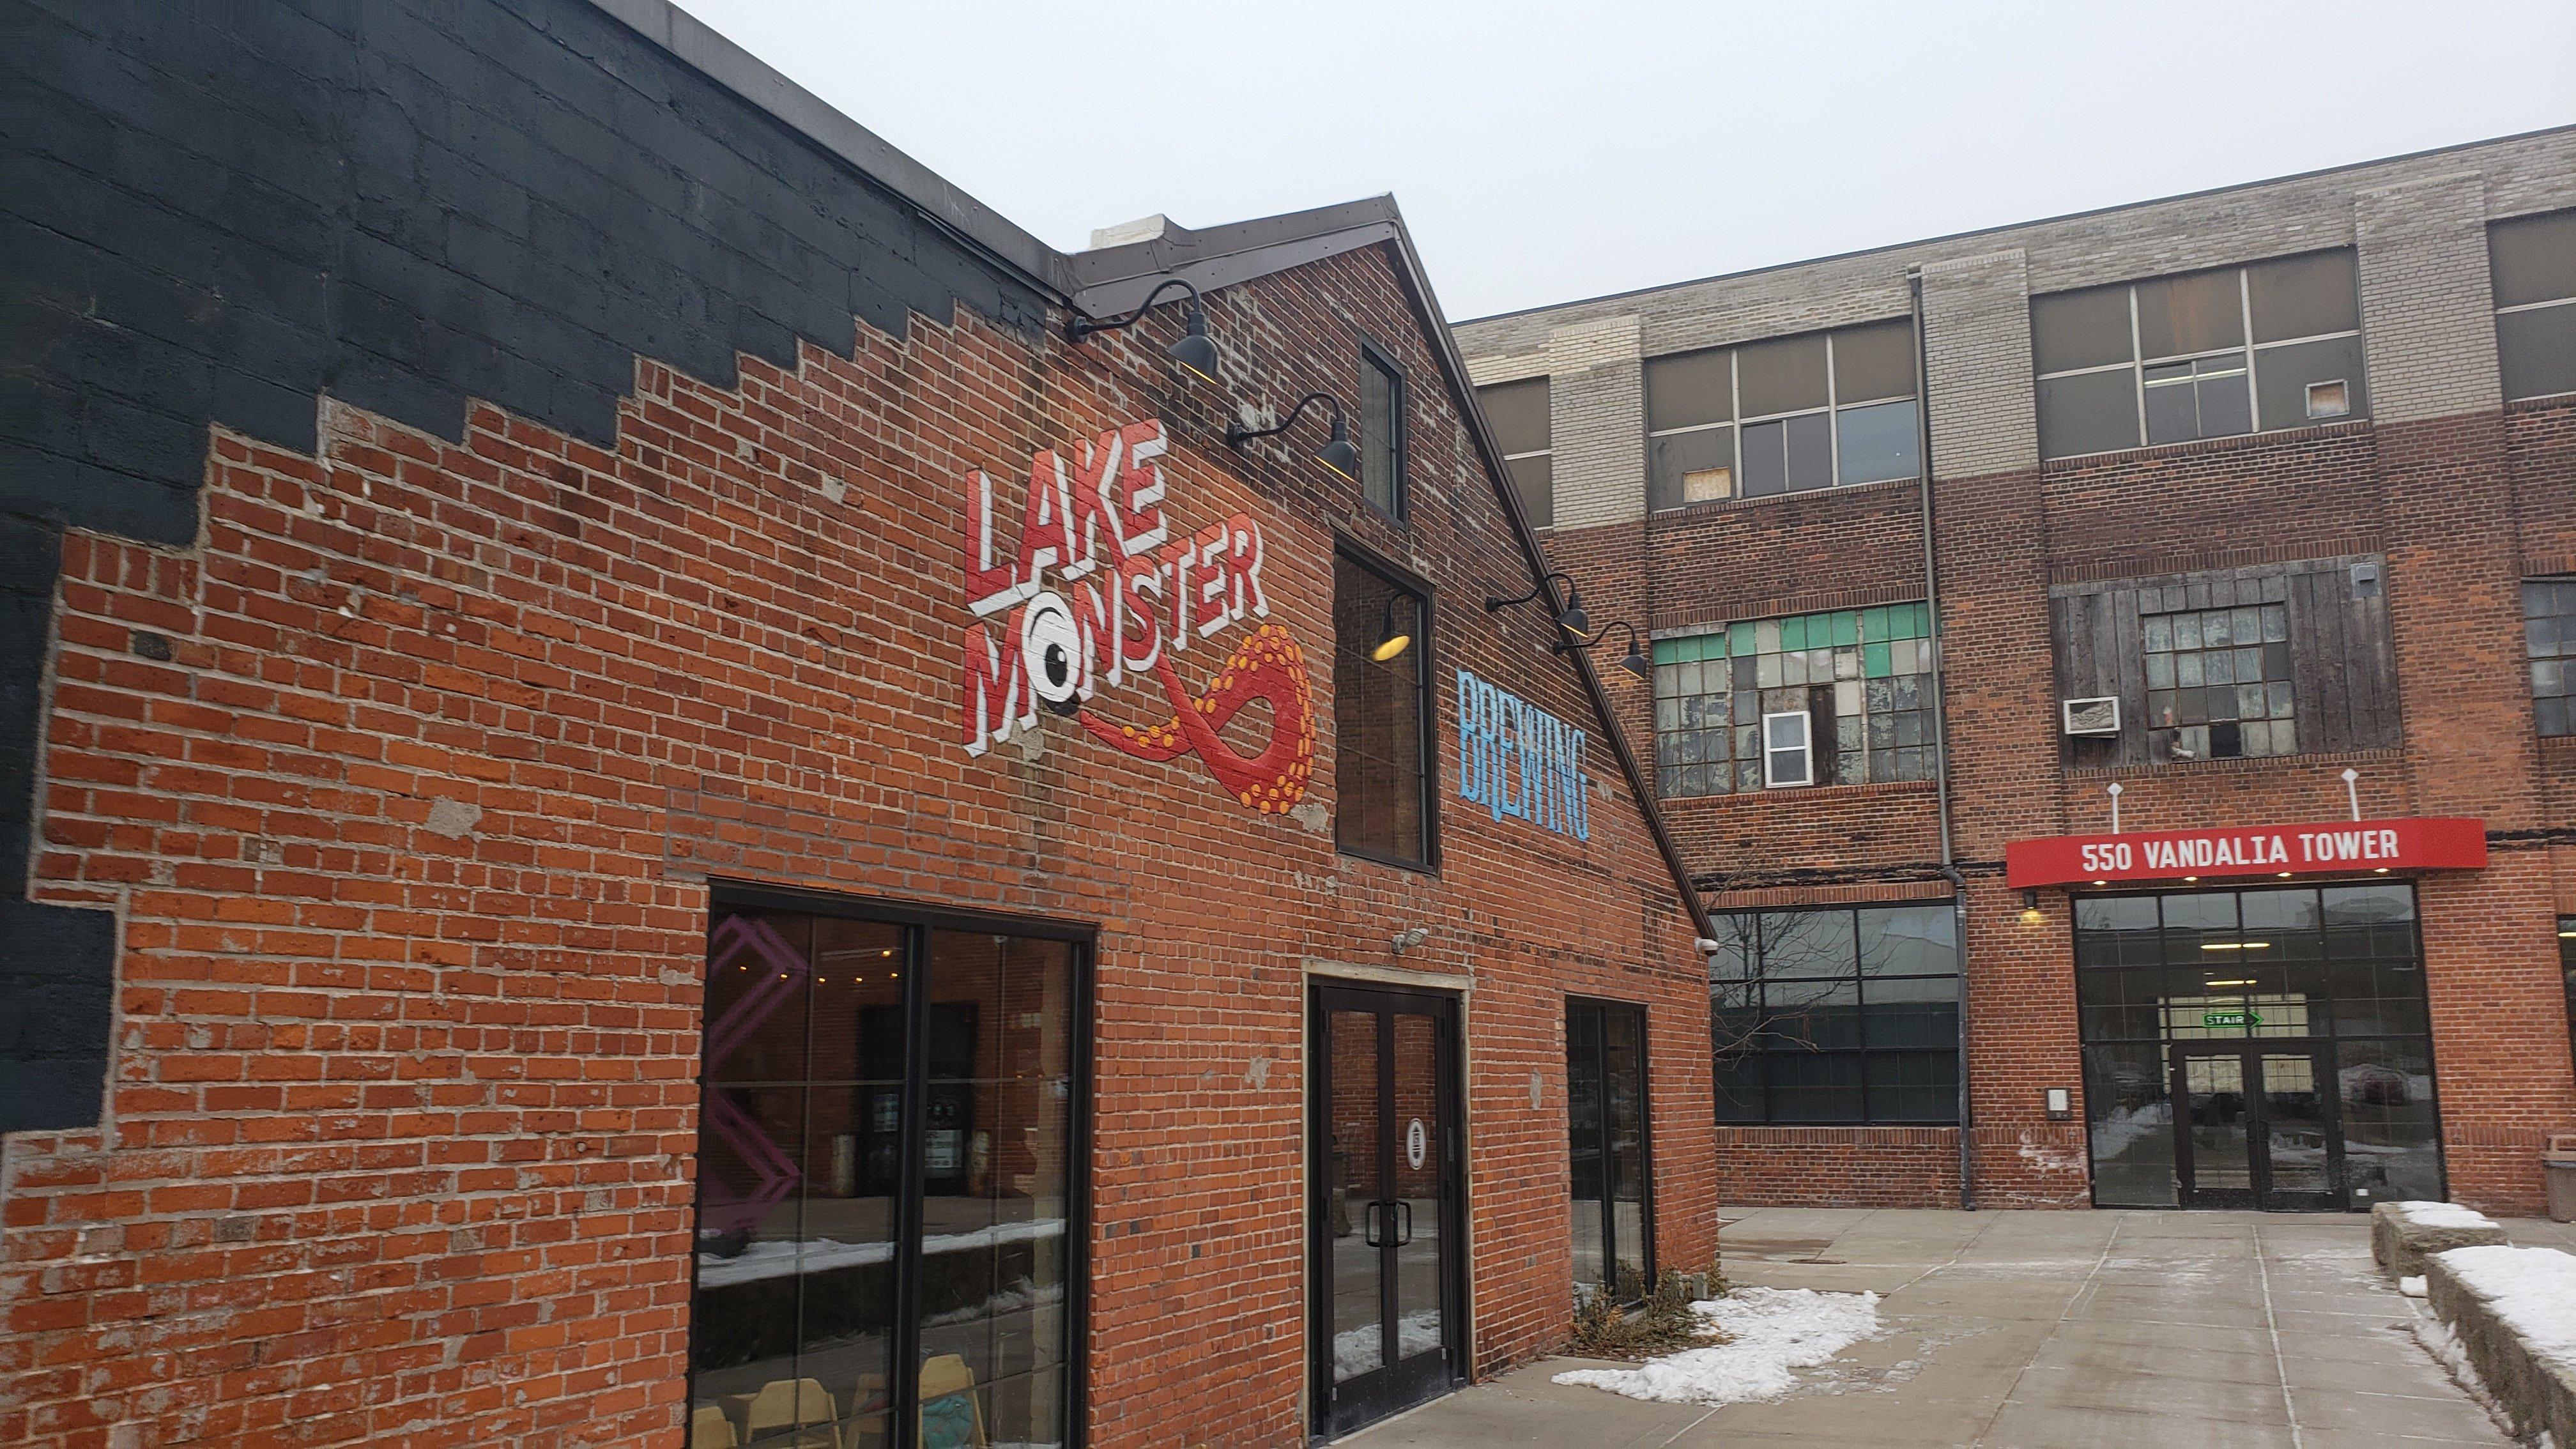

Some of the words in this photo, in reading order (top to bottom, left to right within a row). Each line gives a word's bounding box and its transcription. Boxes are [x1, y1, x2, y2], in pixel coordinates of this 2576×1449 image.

[965, 418, 1168, 617] LAKE
[962, 512, 1270, 758] MONSTER
[1456, 666, 1590, 842] BREWING
[2081, 843, 2133, 872] 550
[2142, 834, 2289, 870] VANDALIA
[2298, 829, 2400, 862] TOWER
[2206, 1016, 2244, 1025] STAIR
